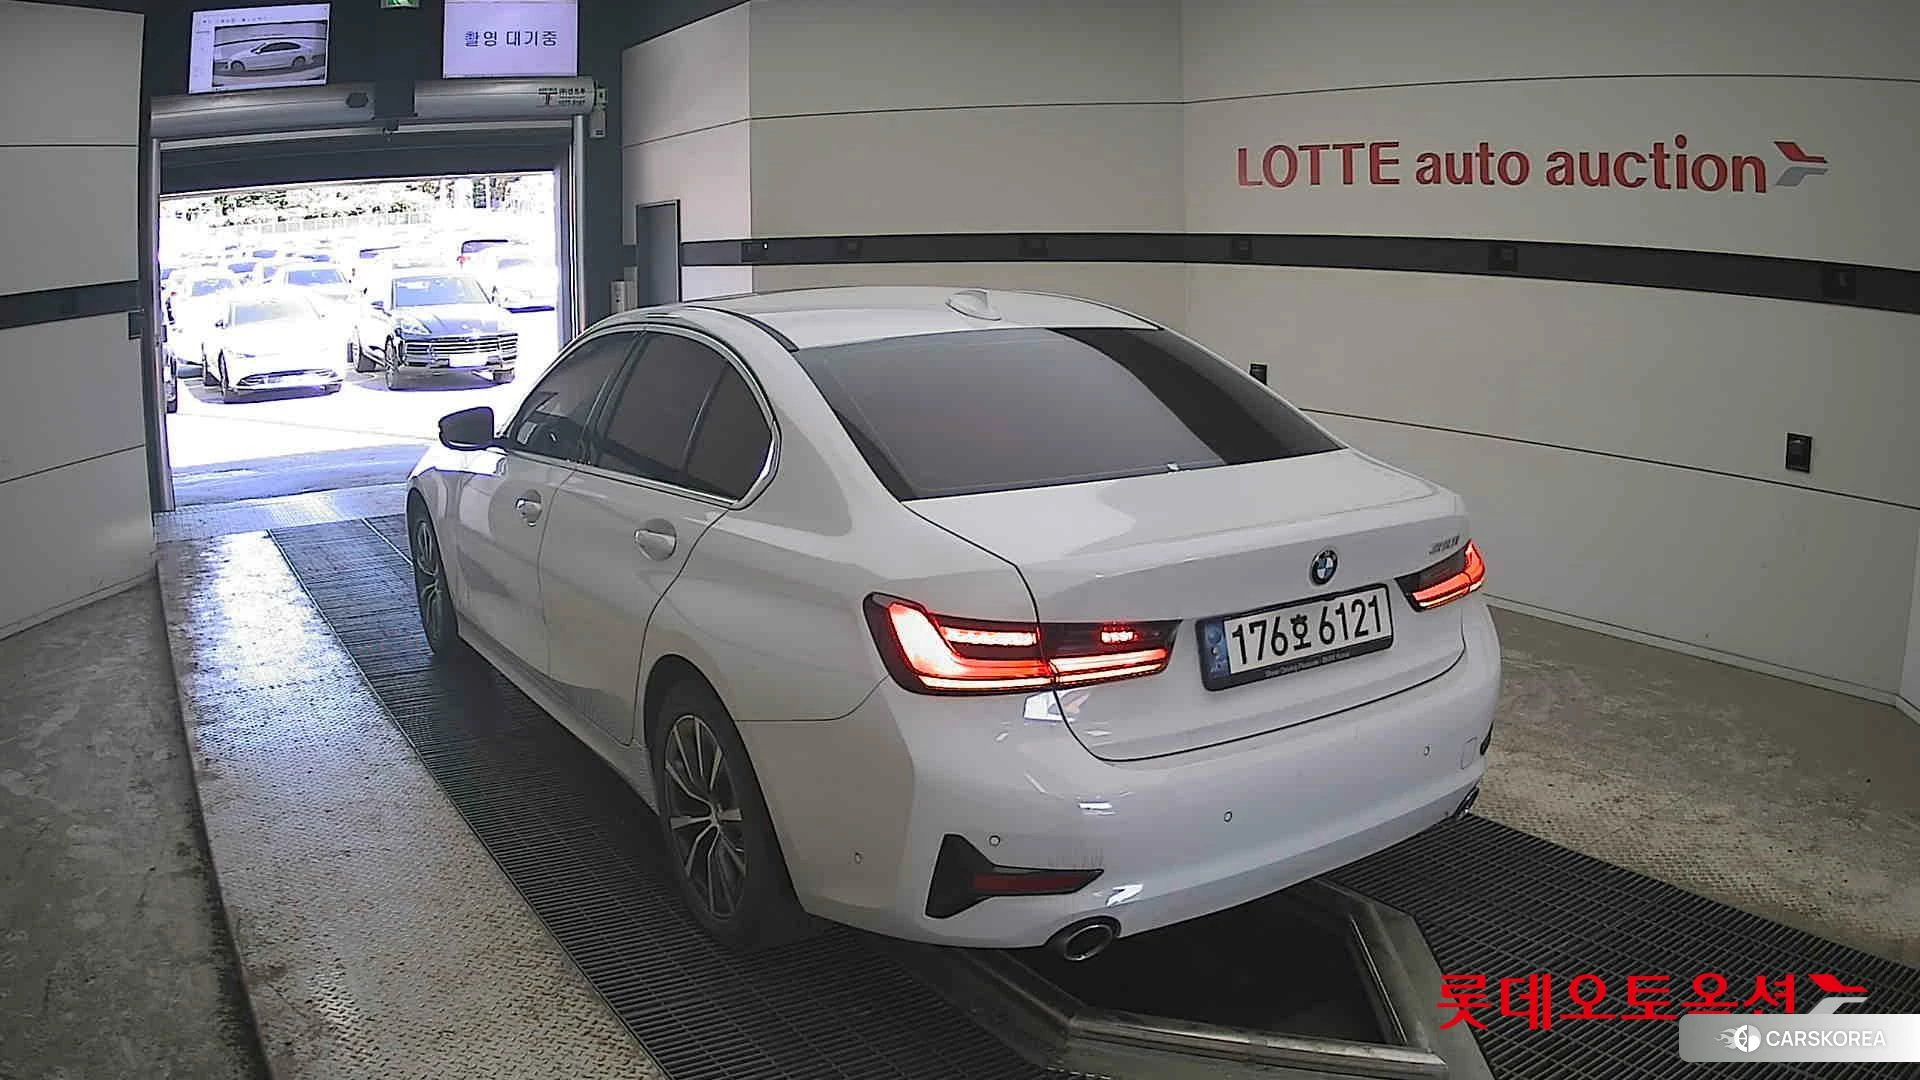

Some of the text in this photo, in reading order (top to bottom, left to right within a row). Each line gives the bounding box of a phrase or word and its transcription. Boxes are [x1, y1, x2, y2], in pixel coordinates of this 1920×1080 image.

[464, 31, 557, 47] 촬영 대기중
[1237, 135, 1767, 193] LOTTE auto auction
[1231, 613, 1312, 665] 176호
[1319, 595, 1381, 645] 6121
